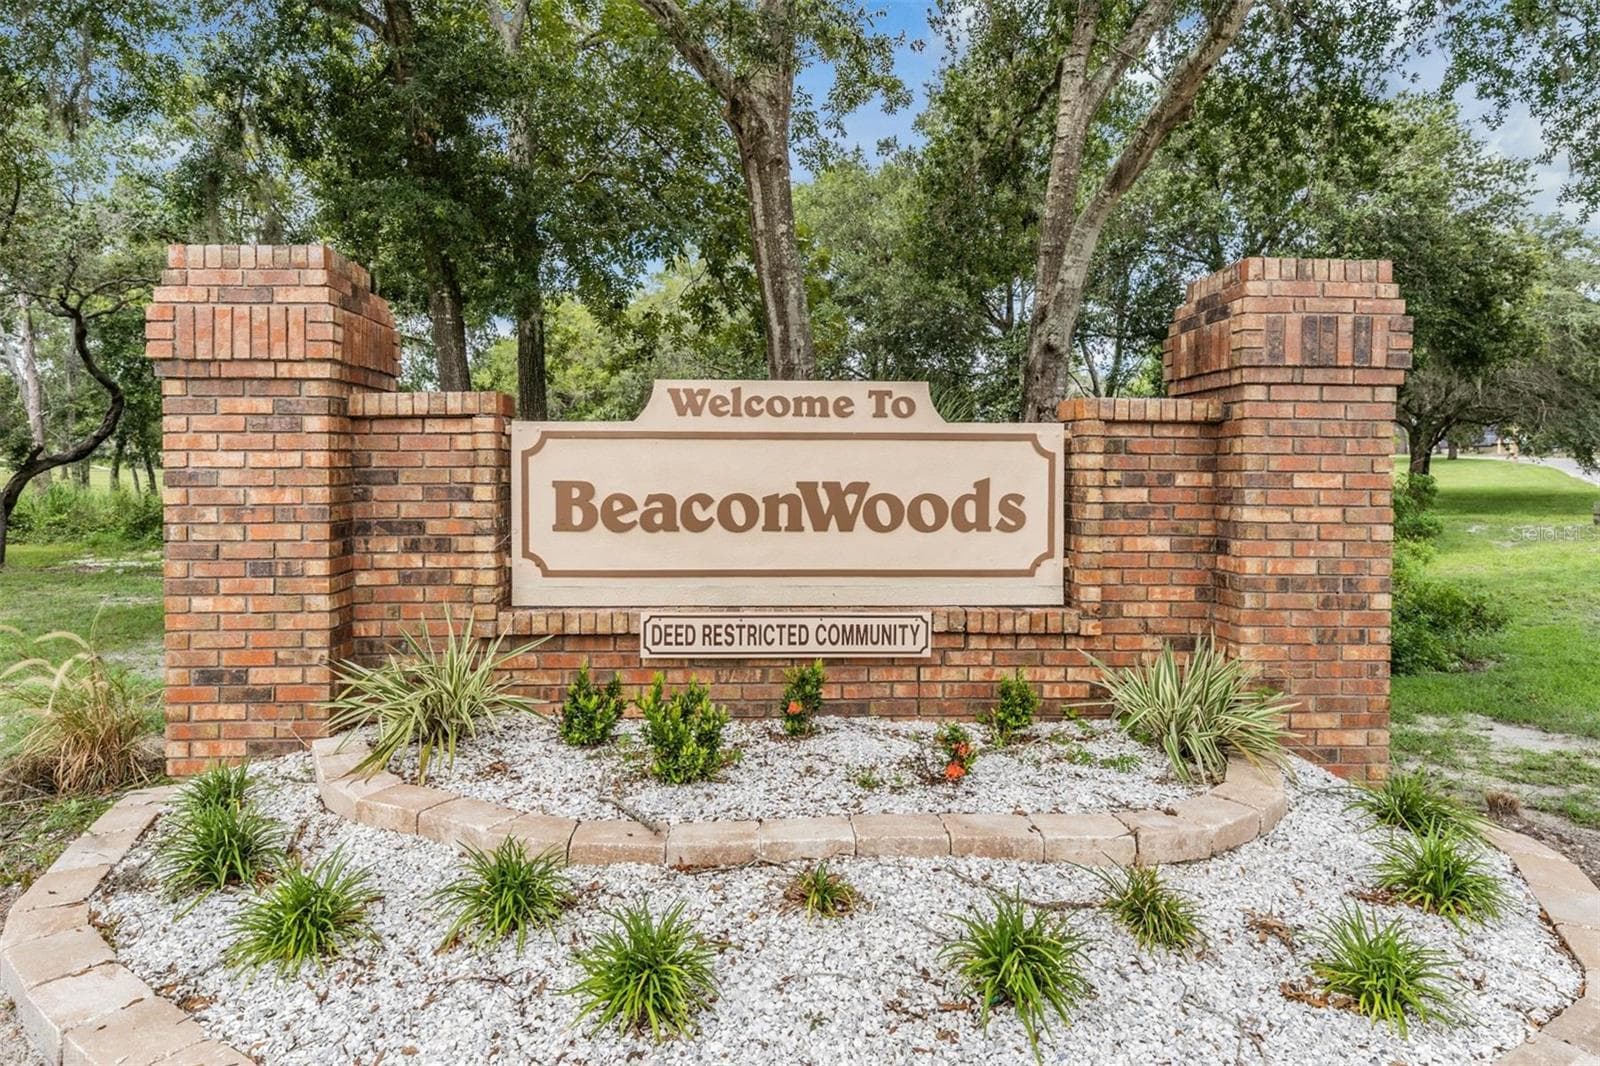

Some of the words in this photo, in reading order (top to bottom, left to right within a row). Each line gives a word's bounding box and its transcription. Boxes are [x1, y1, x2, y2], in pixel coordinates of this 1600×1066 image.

[667, 387, 855, 418] Welcome
[867, 389, 916, 419] To
[551, 477, 1027, 533] BeaconWoods
[650, 623, 697, 647] DEED
[701, 623, 811, 647] RESTRICTED
[814, 623, 921, 647] COMMUNITY
